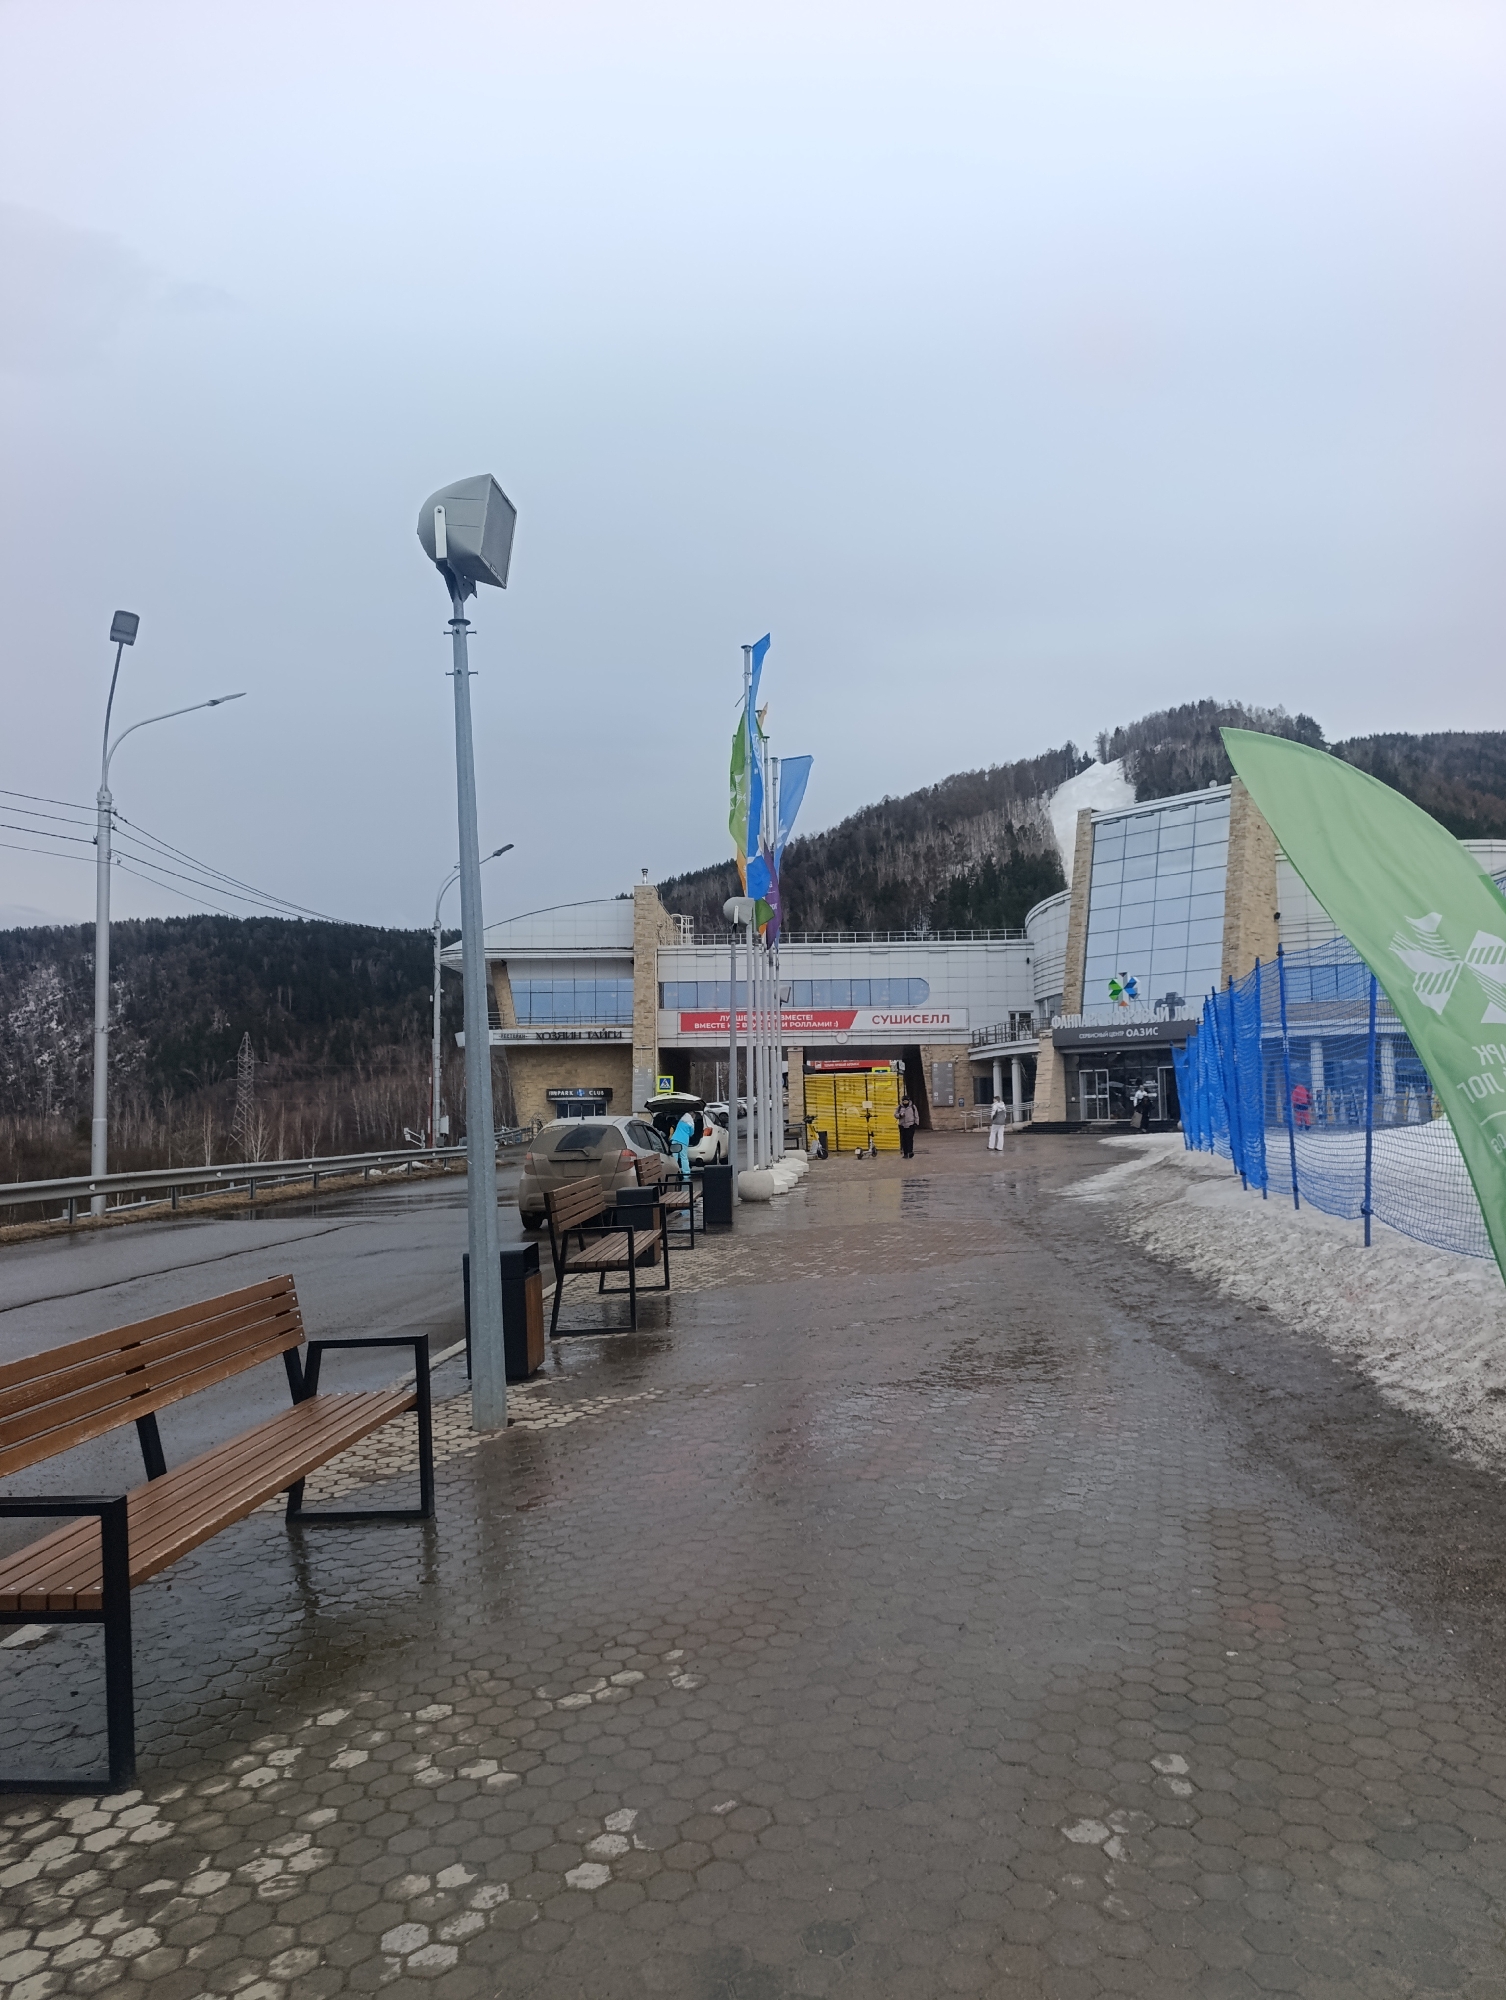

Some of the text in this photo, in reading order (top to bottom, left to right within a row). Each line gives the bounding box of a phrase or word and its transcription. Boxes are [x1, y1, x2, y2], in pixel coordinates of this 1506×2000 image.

[872, 1014, 950, 1025] СУШИСЕЛЛ
[535, 1032, 582, 1041] ХОЗЯИН
[587, 1028, 623, 1040] ТАЙГИ
[1079, 1031, 1108, 1039] СЕРВИСНЫЙ
[1125, 1027, 1159, 1038] ОАЗИС
